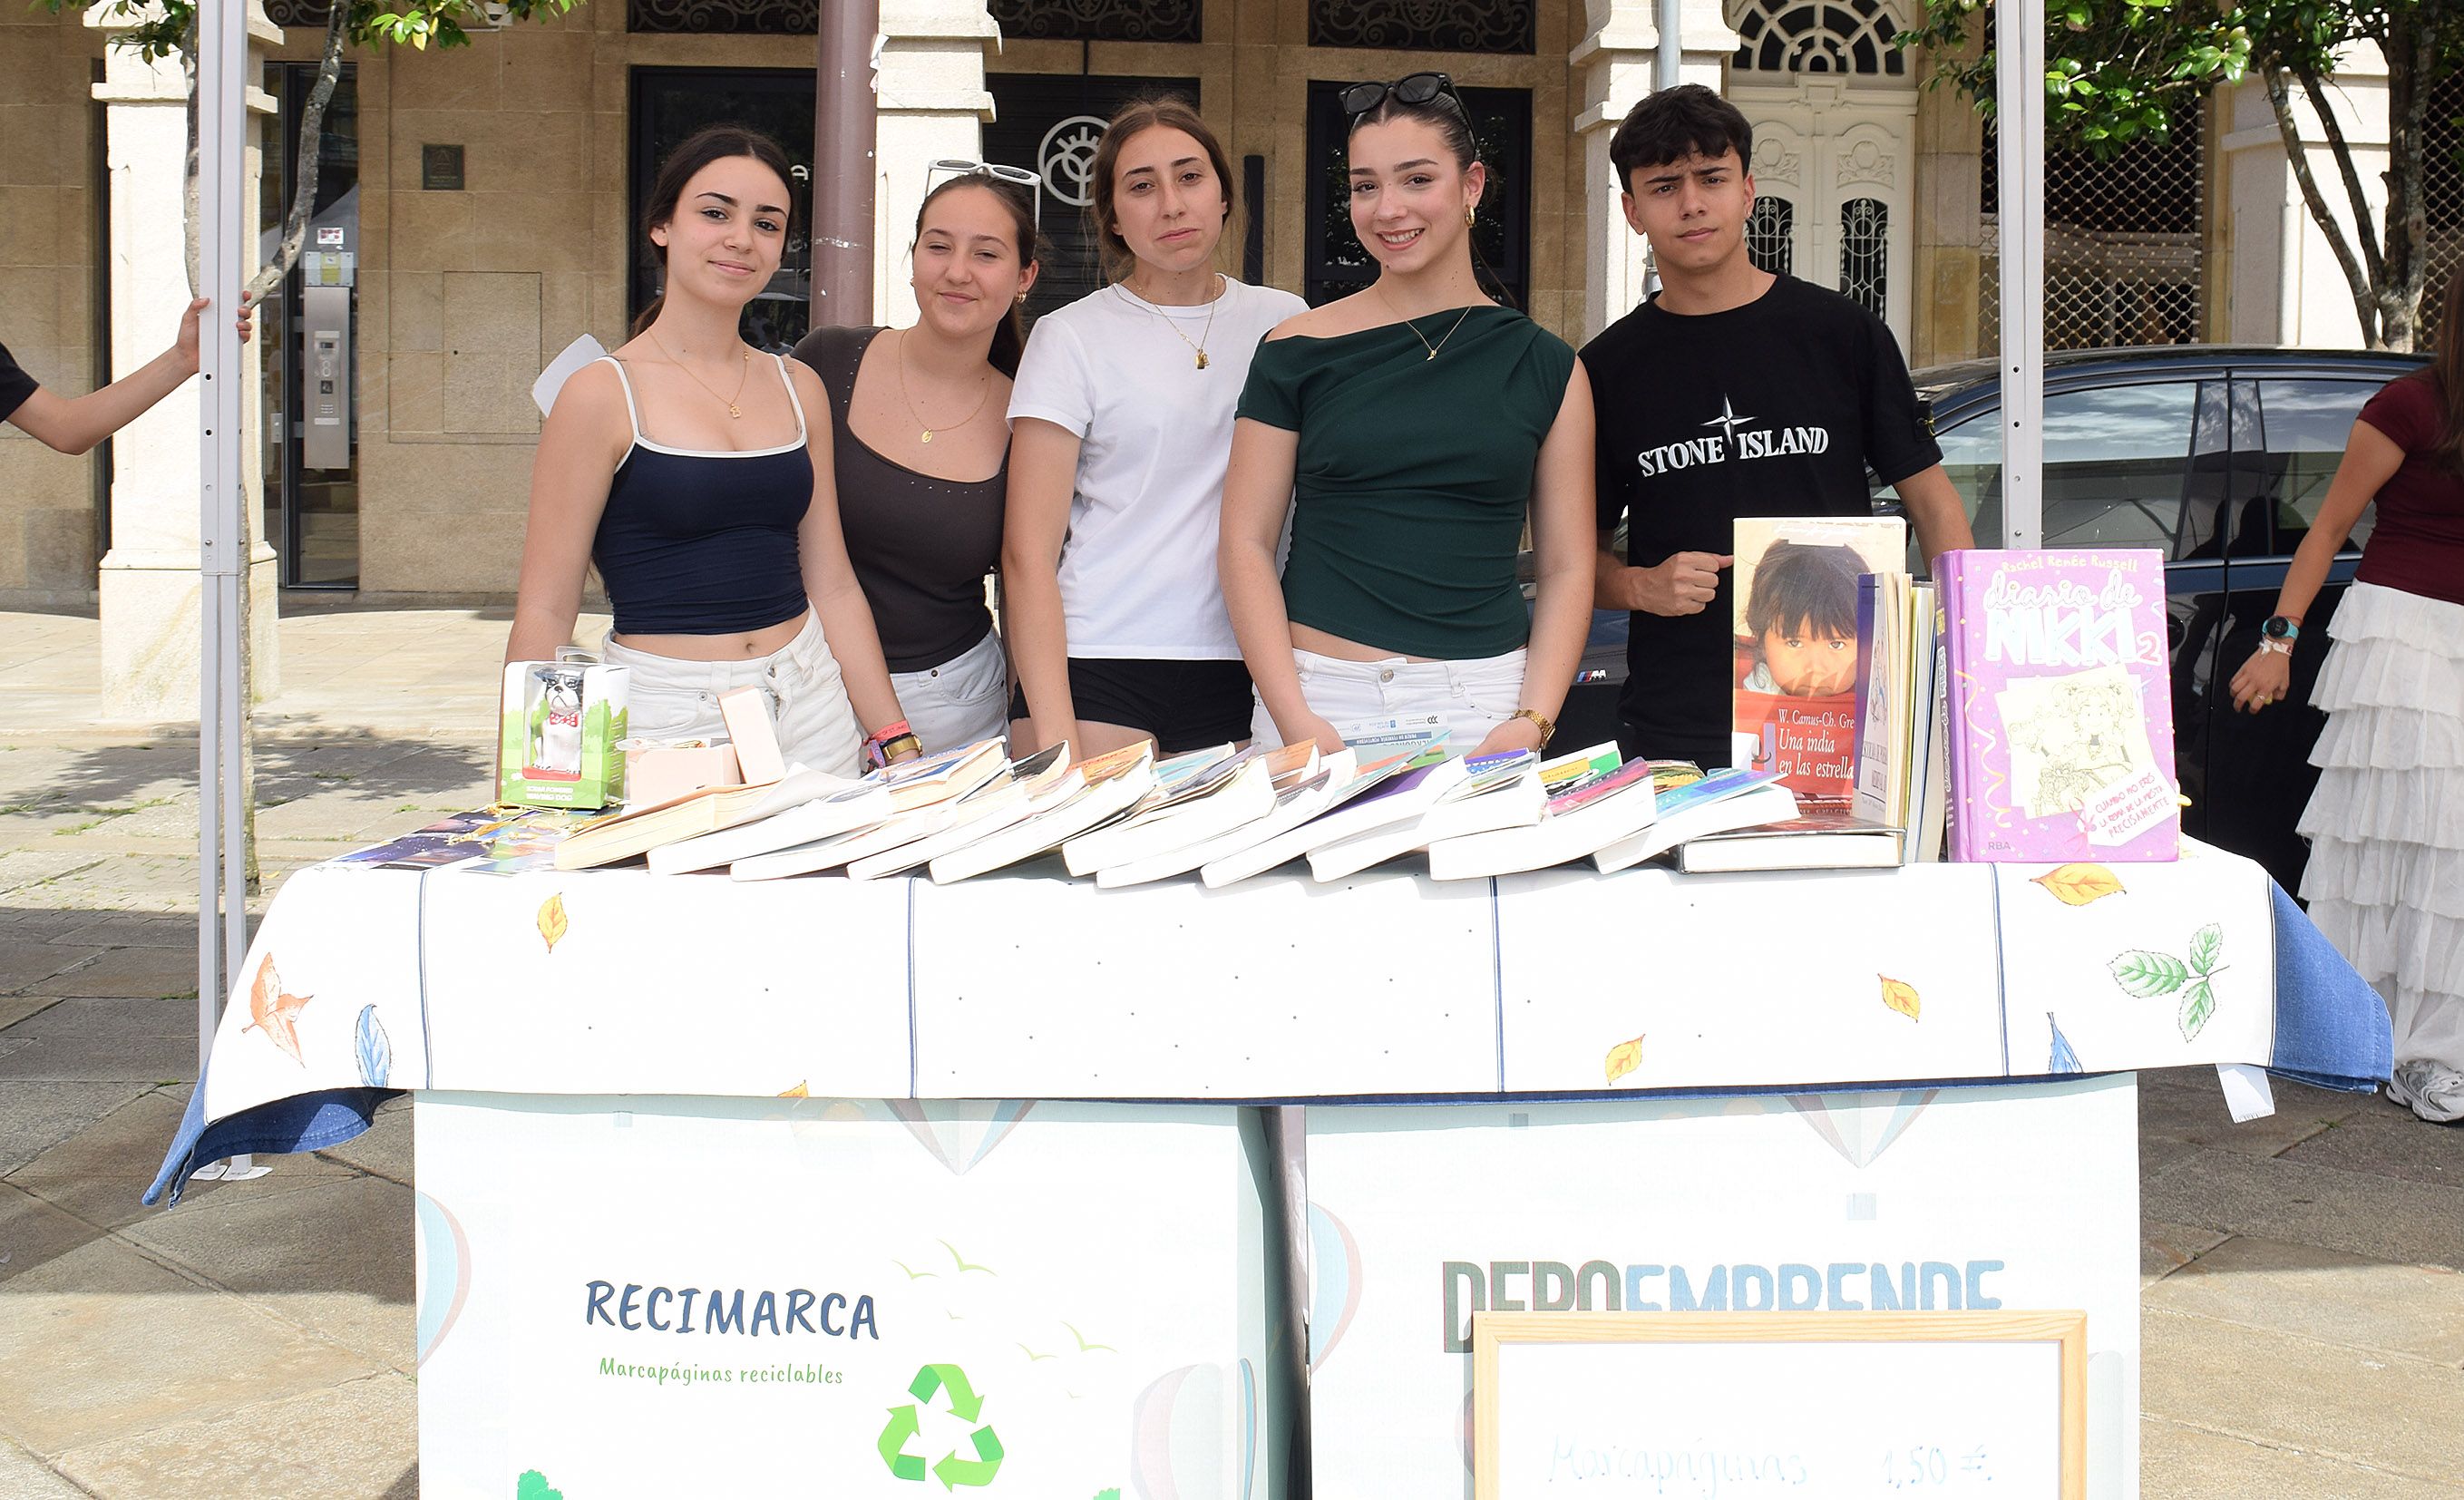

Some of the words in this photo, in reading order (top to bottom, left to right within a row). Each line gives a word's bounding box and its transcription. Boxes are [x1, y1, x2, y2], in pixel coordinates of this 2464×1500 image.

[1638, 435, 1725, 478] STONE
[1736, 426, 1829, 460] ISLAND
[2001, 556, 2044, 572] Rachel
[2048, 554, 2087, 568] Renée
[2091, 554, 2138, 573] Russell
[1982, 570, 2099, 610] diario
[2099, 568, 2143, 610] de
[1983, 606, 2138, 667] NIKKI
[2136, 631, 2163, 667] 2
[1778, 708, 1789, 724] W.
[1792, 709, 1836, 727] Camus-Ch.
[1778, 727, 1803, 751] Una
[1807, 729, 1836, 754] india
[1778, 760, 1793, 774] en
[1797, 753, 1811, 776] las
[1816, 755, 1855, 779] estrella
[2109, 796, 2169, 838] PRECISAMENTE
[1988, 842, 2011, 851] RBA
[586, 1280, 880, 1340] RECIMARCA
[599, 1357, 732, 1387] Marcapáginas
[740, 1363, 842, 1384] reciclables
[1547, 1430, 1808, 1499] Marcapáginas
